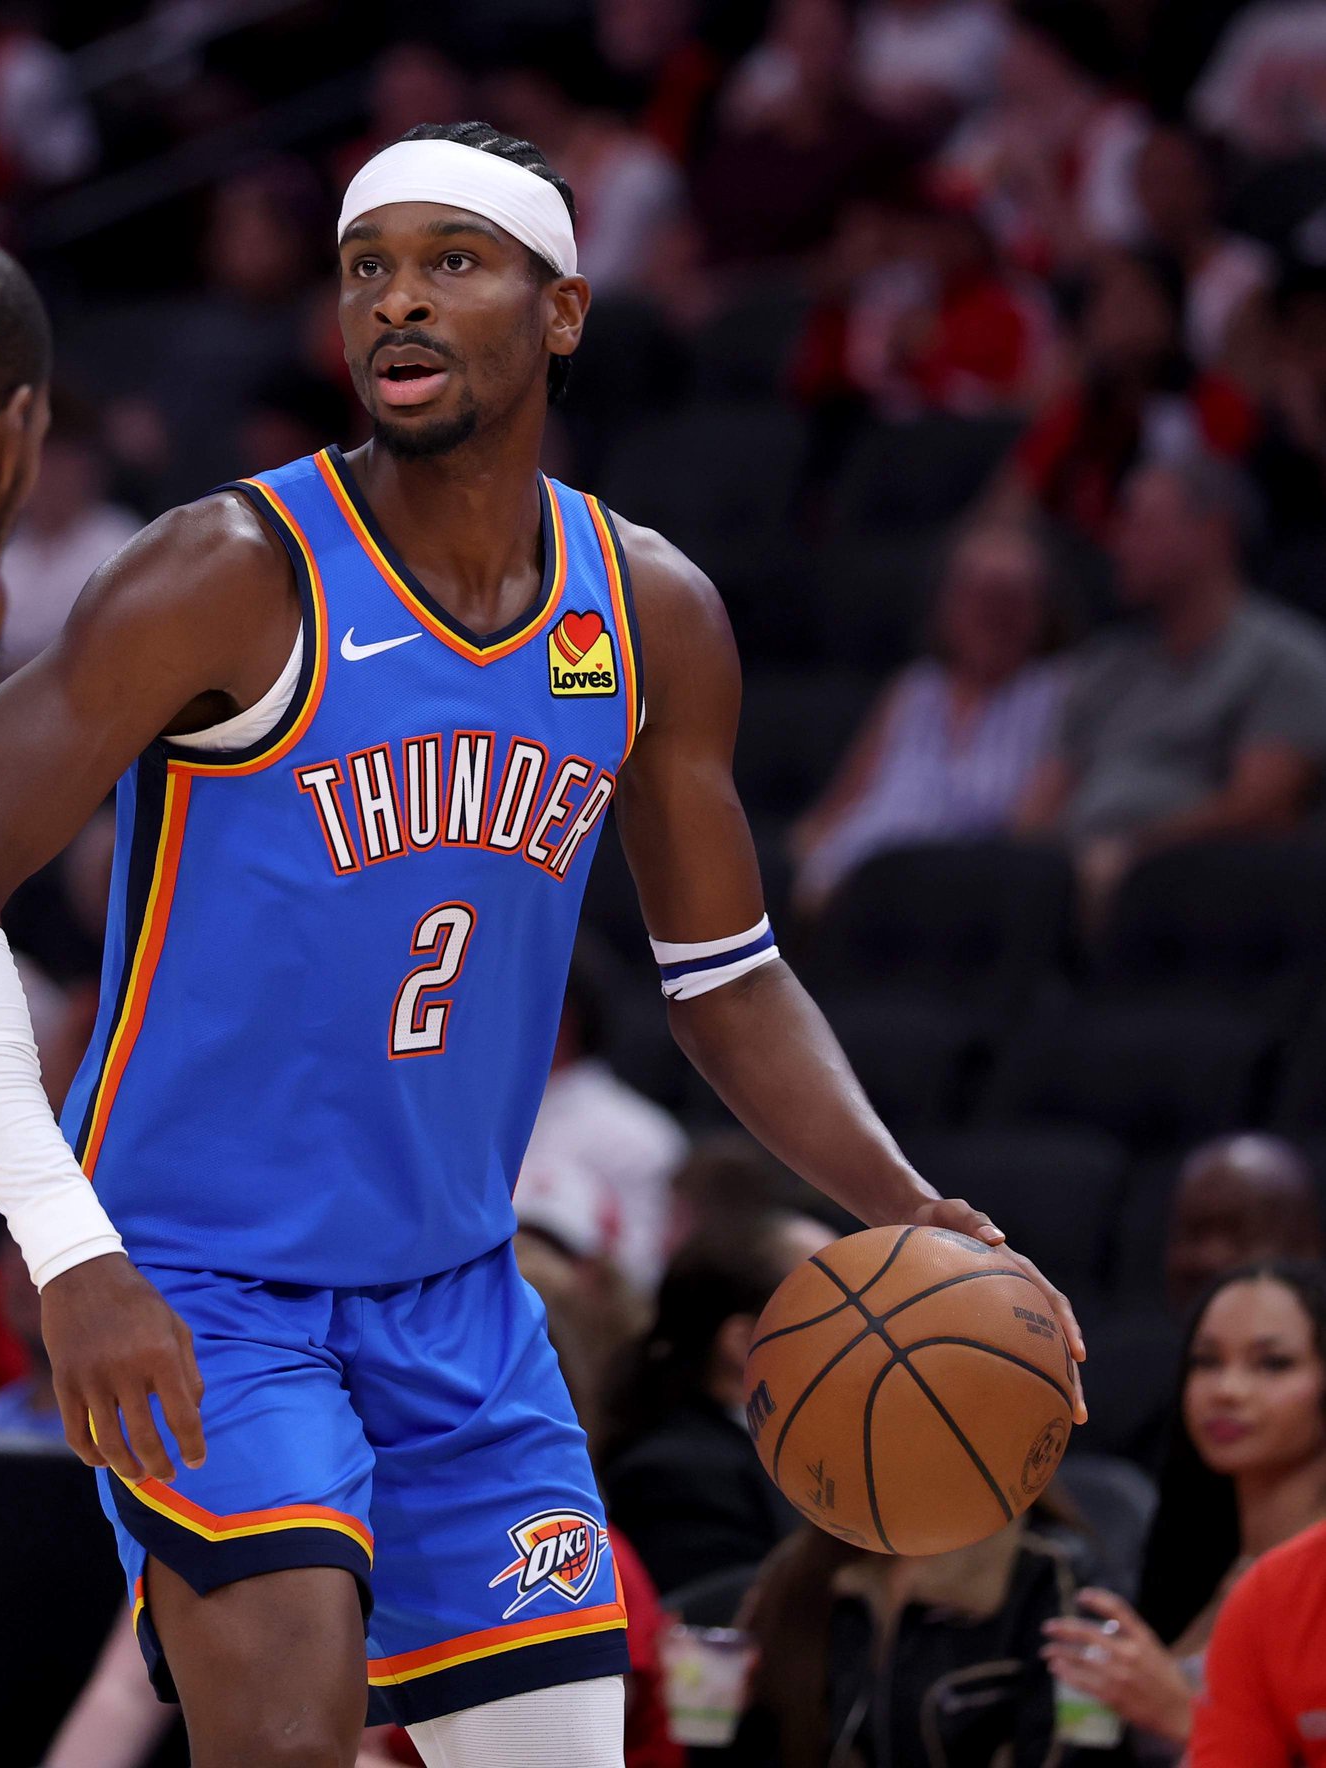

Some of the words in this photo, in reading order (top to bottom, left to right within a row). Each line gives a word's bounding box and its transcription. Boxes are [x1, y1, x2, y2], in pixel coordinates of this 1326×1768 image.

[293, 730, 616, 882] THUNDER
[388, 901, 477, 1060] 2
[524, 1526, 586, 1587] OKC
